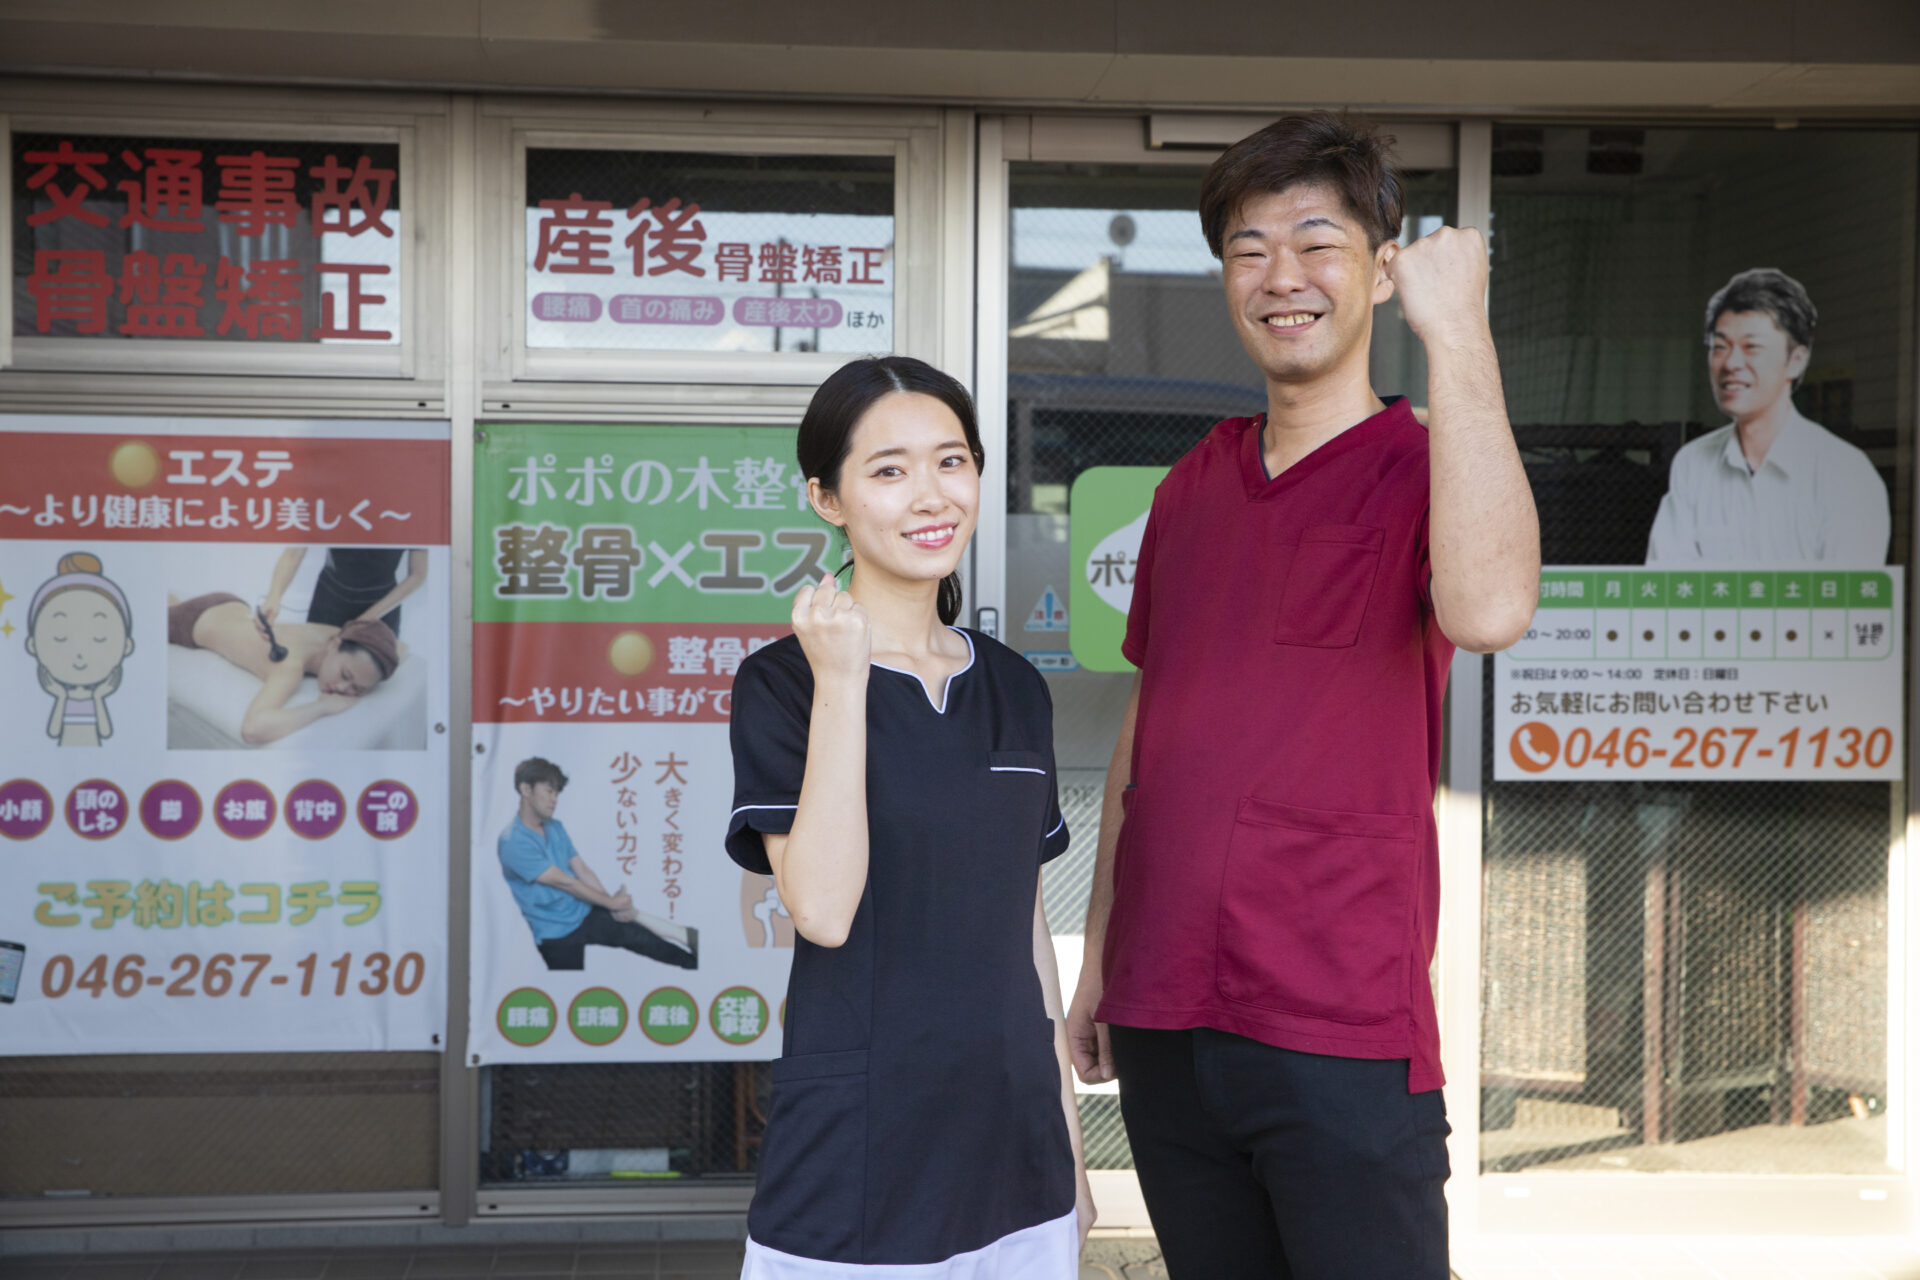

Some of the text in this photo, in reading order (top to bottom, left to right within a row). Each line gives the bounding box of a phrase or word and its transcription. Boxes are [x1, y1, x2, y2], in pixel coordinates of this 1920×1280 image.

[23, 141, 396, 238] 交通事故
[534, 192, 885, 285] 産後 骨盤矯正
[27, 249, 392, 340] 骨盤矯正
[542, 294, 885, 330] 腰痛 首の痛み 産後太り ほか
[166, 449, 294, 488] エステ
[507, 452, 809, 511] ポポの木整
[1090, 550, 1138, 587] ポ
[1604, 580, 1621, 598] 月
[1641, 581, 1658, 598] 火
[1676, 580, 1694, 598] 水
[1712, 580, 1730, 598] 木
[1749, 580, 1766, 598] 金
[1784, 581, 1801, 598] 土
[1821, 580, 1838, 598] 日
[1860, 580, 1879, 598] 祝
[1510, 690, 1829, 715] お気軽にお問い合わせ下さい
[1563, 725, 1893, 769] 046-267-1130
[0, 799, 43, 821] 小顔
[78, 810, 119, 832] しわ
[223, 798, 267, 821] お腹
[293, 798, 337, 822] 背中
[610, 751, 643, 876] 少ない力で
[34, 878, 384, 930] ご予約はコチラ
[41, 951, 426, 999] 046-267-1130
[647, 1005, 690, 1026] 産後
[717, 996, 759, 1017] 交通
[717, 1016, 760, 1037] 事故
